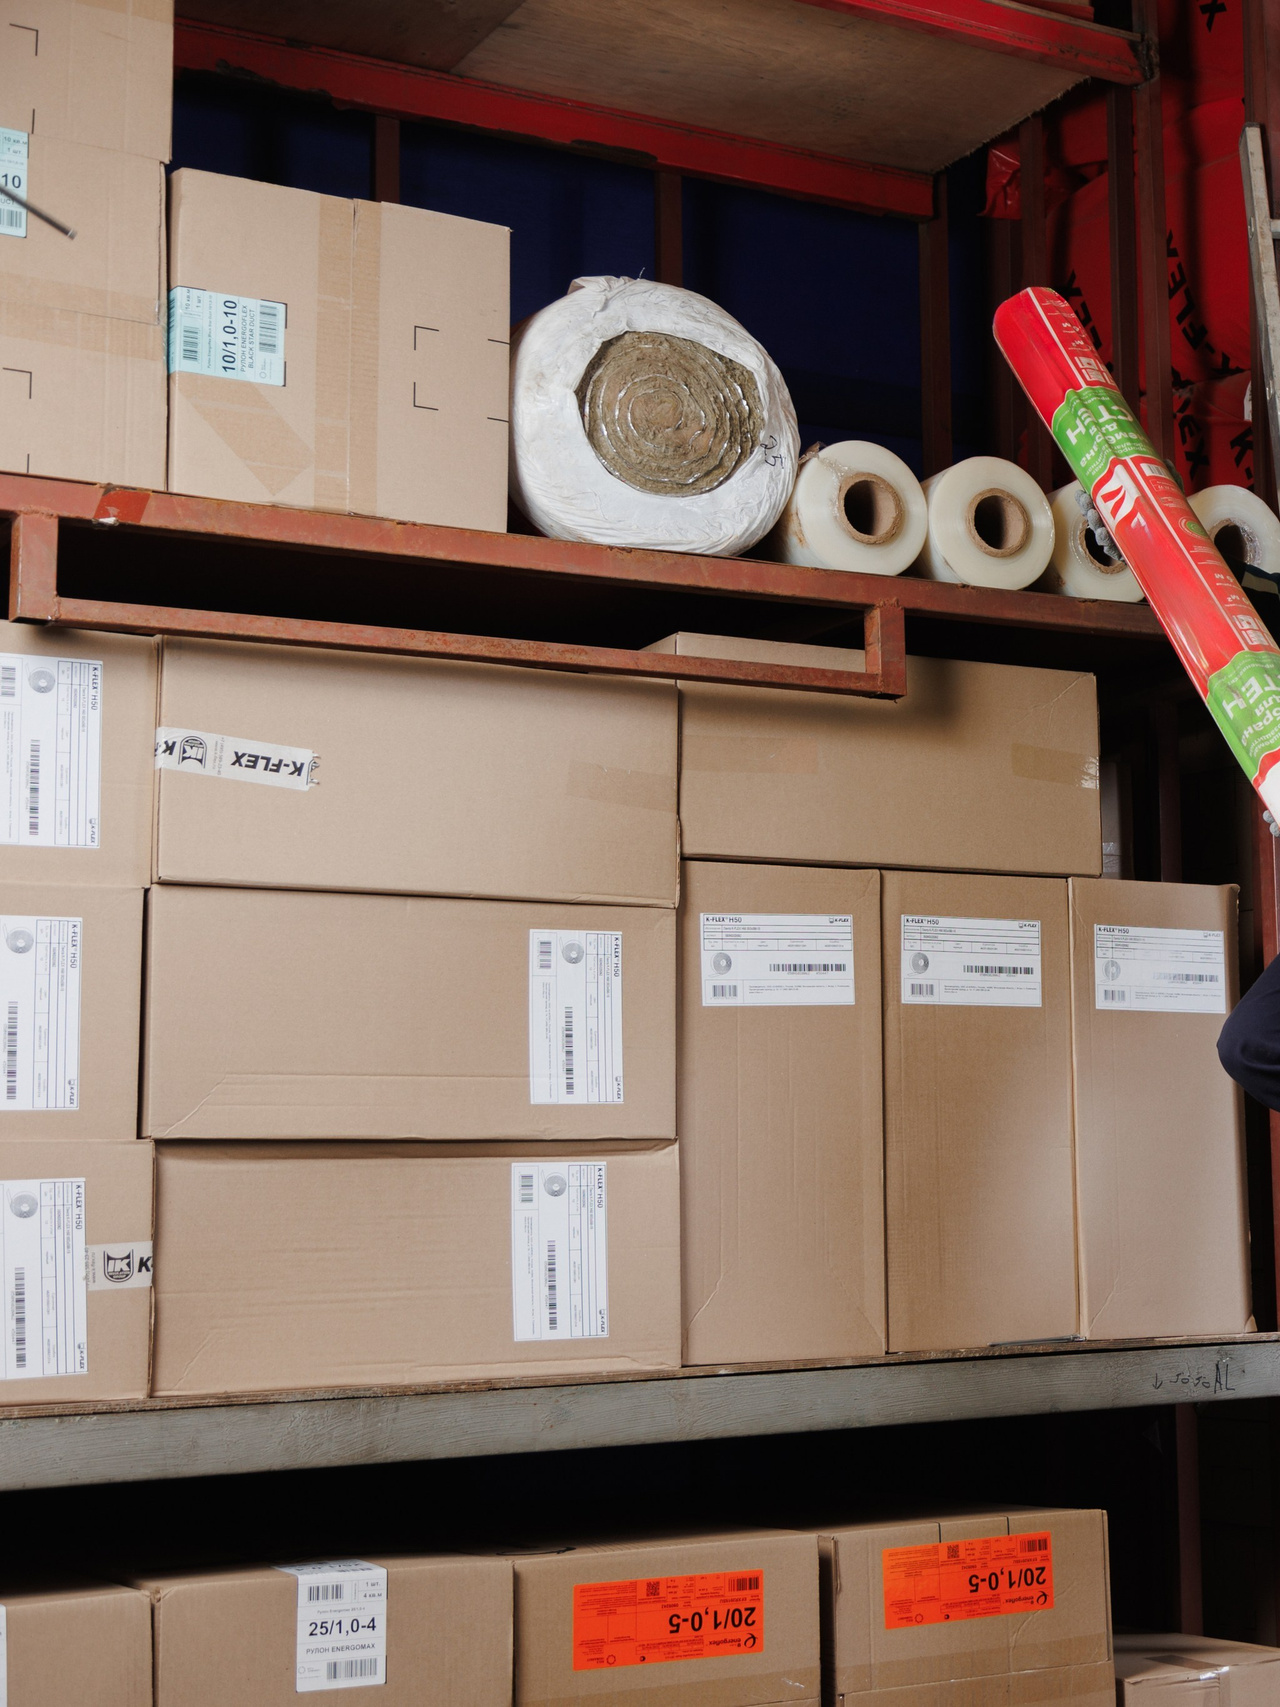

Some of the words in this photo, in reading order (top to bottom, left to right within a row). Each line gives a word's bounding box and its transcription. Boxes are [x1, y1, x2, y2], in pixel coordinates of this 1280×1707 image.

[222, 300, 239, 373] 10/1,0-10
[231, 751, 305, 777] K-FLEX
[969, 1566, 1046, 1593] 20/1,0-5
[308, 1617, 377, 1636] 25/1,0-4
[668, 1606, 756, 1634] 20/1,0-5
[306, 1647, 330, 1655] РУЛОН
[331, 1643, 376, 1653] ENERGOMAX
